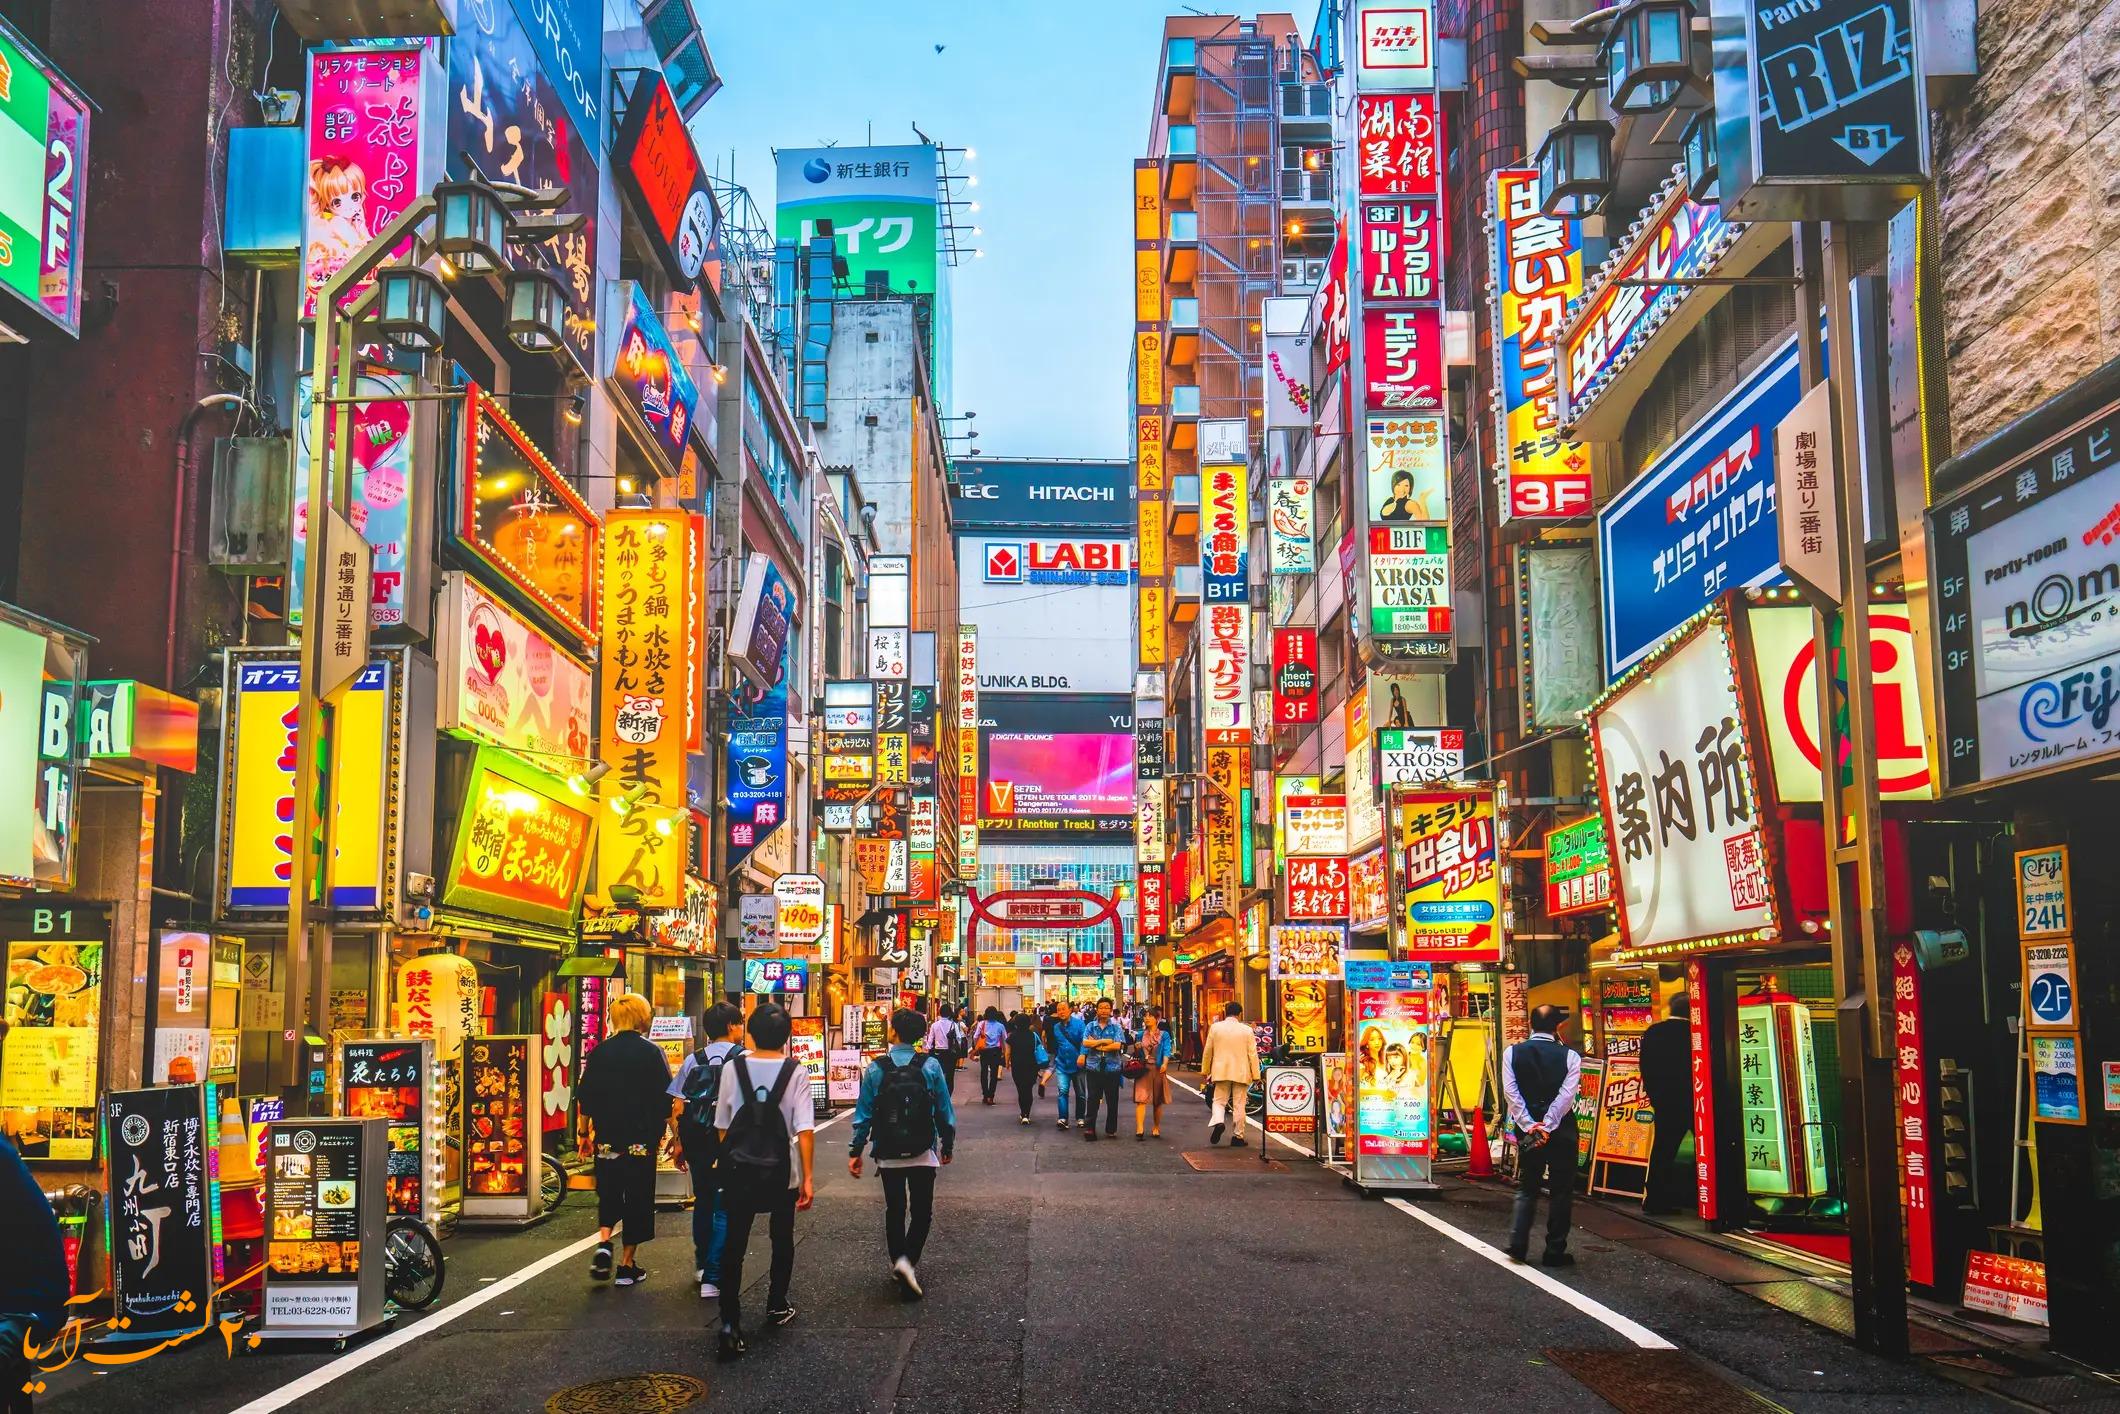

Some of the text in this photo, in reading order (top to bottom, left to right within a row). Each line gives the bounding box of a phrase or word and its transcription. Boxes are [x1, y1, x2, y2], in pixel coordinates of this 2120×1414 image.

[1375, 26, 1416, 36] カブキ
[1369, 36, 1421, 47] ラウンジ
[319, 57, 417, 75] リラクゼーション
[1761, 5, 1905, 130] RIZ
[339, 76, 395, 94] リゾート
[325, 111, 357, 126] 当ビル
[1361, 98, 1433, 140] 湖南
[324, 126, 353, 140] 6F
[1849, 128, 1889, 149] B1
[1362, 141, 1434, 179] 菜館
[641, 123, 682, 219] CLOVER
[836, 161, 910, 179] 新生銀行
[1385, 180, 1411, 193] 4F
[48, 139, 73, 269] 2F
[1370, 207, 1395, 222] 3F
[1150, 242, 1157, 250] 9
[1403, 205, 1431, 297] レンタル
[1371, 229, 1399, 297] ルーム
[1151, 323, 1157, 332] 8
[1295, 338, 1307, 346] 5F
[1385, 312, 1418, 383] エデン
[1152, 407, 1158, 416] 7
[1386, 420, 1438, 434] タイ古式
[1371, 434, 1439, 449] マッサージ
[1272, 481, 1283, 489] 4F
[1670, 430, 1753, 524] マクロス
[1950, 427, 2113, 535] 第一桑原ビ
[1029, 486, 1115, 501] HITACHI
[1153, 492, 1160, 501] 6
[1515, 480, 1587, 512] 3F
[1795, 431, 1823, 555] 劇場通り一番街
[1212, 472, 1238, 576] まぐろ商店
[1392, 530, 1424, 549] B1F
[1028, 542, 1129, 571] LABI
[1984, 535, 2068, 586] Party-room
[1029, 571, 1091, 585] SHINJUKU
[1154, 578, 1160, 588] 5
[1374, 568, 1445, 586] XROSS
[1704, 561, 1728, 597] 2F
[1207, 582, 1244, 598] B1F
[1943, 576, 1965, 598] 5F
[334, 551, 357, 657] 劇場通り一番街
[1382, 588, 1437, 606] CASA
[613, 525, 642, 692] 九州のうまかもん
[1945, 612, 1968, 634] 4F
[873, 635, 889, 673] 桜島
[1381, 643, 1450, 655] 第一大滝ビル
[643, 624, 672, 695] 水炊き
[1947, 651, 1969, 671] 3F
[961, 640, 975, 721] お好み焼き
[1284, 664, 1315, 680] meat
[1031, 675, 1071, 689] BLDG.
[1281, 674, 1312, 689] house
[886, 682, 905, 730] リラク
[1225, 702, 1247, 727] J
[1284, 702, 1309, 720] 3F
[618, 710, 659, 733] 新宿
[732, 717, 783, 731] GREAT
[631, 731, 646, 742] の
[735, 732, 778, 746] BLUE
[1217, 730, 1240, 742] 4F
[1383, 734, 1393, 744] 肉
[886, 736, 904, 767] 麻雀
[1953, 737, 1974, 758] 2F
[1387, 752, 1458, 768] XROSS
[886, 769, 904, 782] 2F
[1141, 768, 1160, 776] 3F
[1396, 767, 1451, 782] CASA
[1013, 785, 1042, 793] SE7EN
[1106, 794, 1128, 802] Japan
[1614, 716, 1750, 865] 案内所
[1310, 798, 1324, 806] 2F
[732, 803, 777, 845] 麻雀
[963, 814, 973, 822] 4F
[1142, 802, 1154, 846] バンタイ
[1410, 794, 1478, 836] キラリ
[1290, 821, 1345, 831] マッサージ
[472, 814, 506, 860] 新宿
[1409, 816, 1488, 885] 出会い
[477, 855, 489, 872] の
[502, 834, 572, 899] まっちゃん
[890, 841, 905, 881] 居酒屋
[1142, 864, 1161, 873] 焼肉
[2036, 855, 2063, 880] Fiji
[1290, 858, 1346, 889] 湖南
[1443, 861, 1493, 900] カフェ
[1143, 877, 1161, 931] 安楽亭
[1291, 889, 1333, 916] 菜館
[1334, 889, 1347, 915] 4F
[2025, 890, 2065, 905] 年中無休
[784, 908, 819, 924] 190円
[1009, 904, 1081, 915] 歌舞伎町一番街
[2025, 903, 2067, 931] 24H
[33, 908, 73, 934] B1
[1145, 935, 1160, 944] 2F
[1416, 935, 1469, 947] 受付3F
[764, 962, 803, 990] 麻雀
[184, 968, 192, 1007] 防犯カメラ
[2036, 979, 2069, 1011] 2F
[1305, 1036, 1325, 1047] B1
[348, 1049, 374, 1058] 鍋料理
[348, 1060, 417, 1084] 花たろう
[1739, 1024, 1769, 1163] 無料案内所
[1895, 975, 1926, 1210] 絶対安心宣言!!
[259, 1110, 280, 1121] カフェ
[1605, 1107, 1634, 1122] キラリ
[1268, 1122, 1313, 1131] COFFEE
[276, 1136, 289, 1146] 6F
[162, 1118, 180, 1189] 新宿東口店
[183, 1117, 202, 1228] 博多水炊き専門店
[1971, 1255, 2046, 1278] ここにごみを
[1968, 1268, 2046, 1293] 捨てないで下
[301, 1296, 320, 1304] 03:00
[1964, 1294, 2018, 1312] garbage here
[1965, 1285, 2049, 1310] Please do not throw
[271, 1307, 352, 1316] TEL:03-6228-0567
